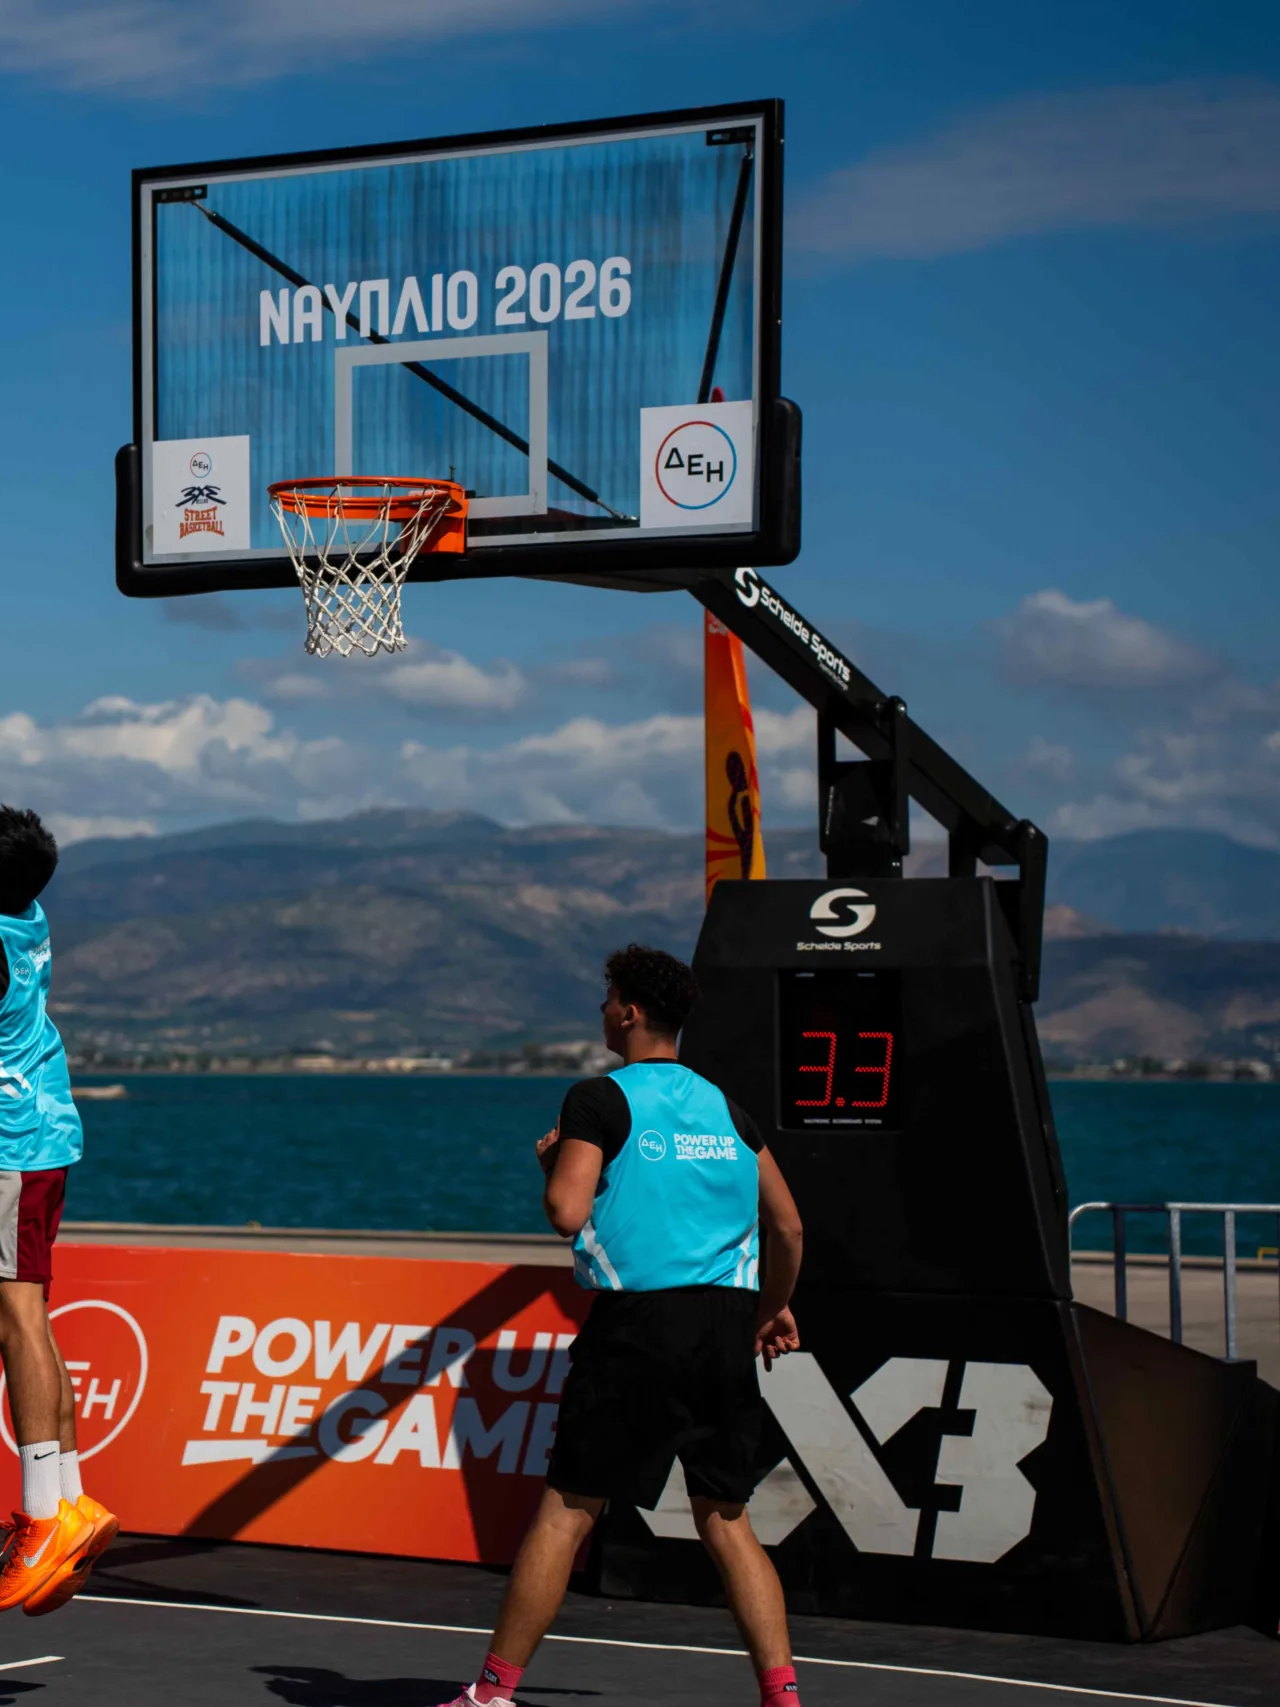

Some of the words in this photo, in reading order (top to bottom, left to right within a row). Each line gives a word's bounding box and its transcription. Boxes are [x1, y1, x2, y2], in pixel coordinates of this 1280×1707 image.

[260, 270, 478, 346] ΝΑΥΠΛΙΟ
[495, 256, 632, 326] 2026
[192, 459, 209, 471] ΔΕΗ
[664, 447, 724, 483] ΔΕΗ
[184, 506, 217, 522] STREET
[179, 520, 225, 539] BASKETBALL
[760, 586, 810, 644] Schelde
[810, 633, 851, 682] Sports
[796, 942, 842, 951] Schelde
[844, 942, 881, 952] Sports
[795, 1032, 893, 1107] 3.3
[641, 1138, 663, 1153] ΔΕΗ
[673, 1133, 718, 1146] POWER
[719, 1135, 735, 1147] UP
[205, 1315, 477, 1389] POWER
